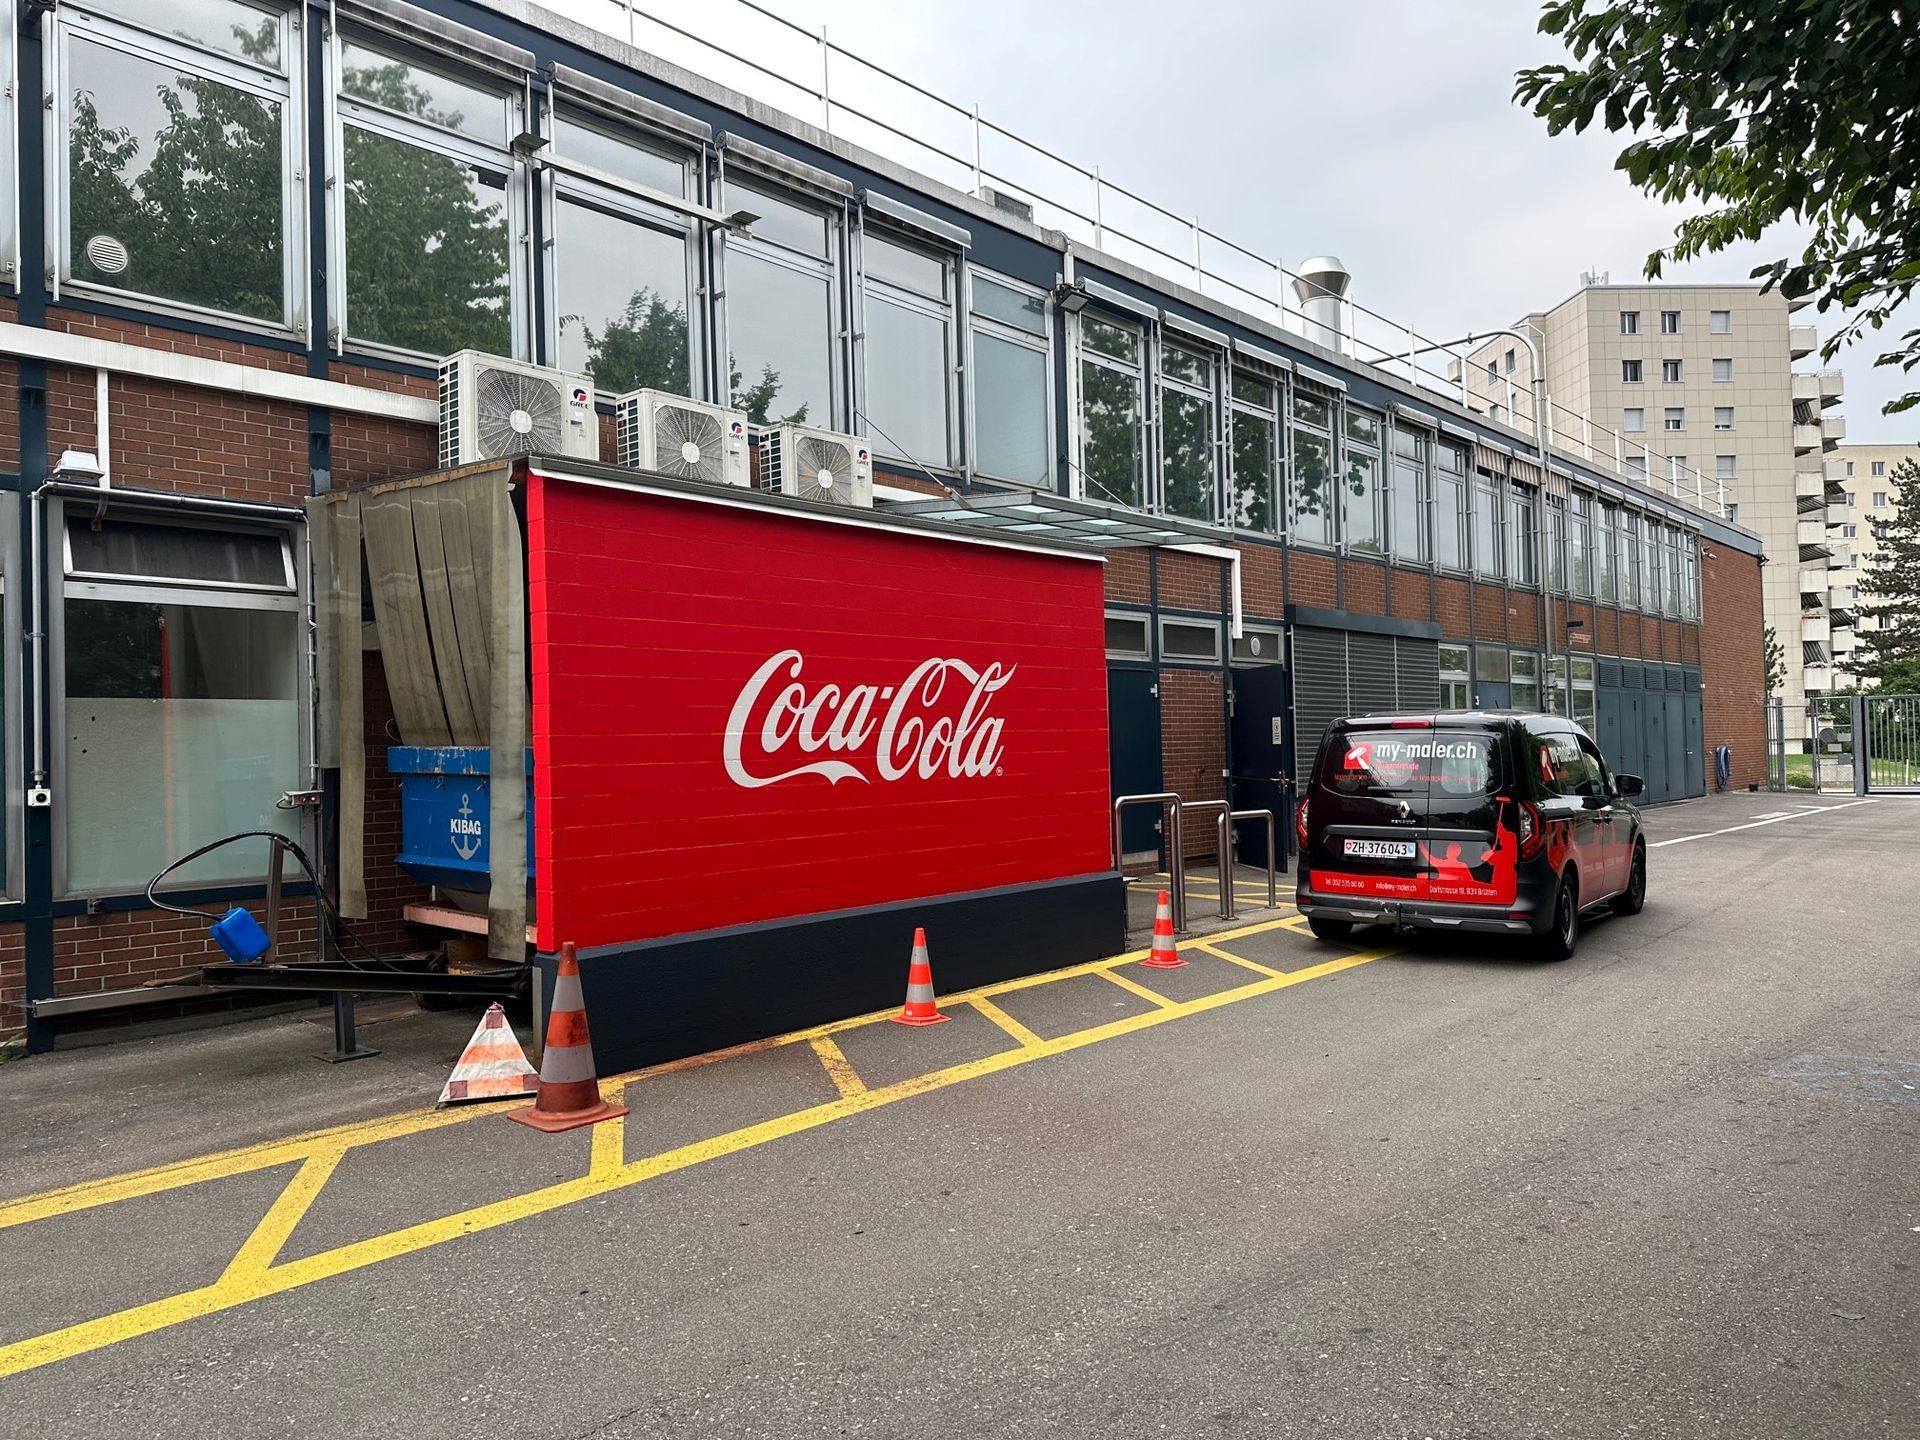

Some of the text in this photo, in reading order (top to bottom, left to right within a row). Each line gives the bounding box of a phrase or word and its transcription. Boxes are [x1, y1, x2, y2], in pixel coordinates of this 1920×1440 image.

[569, 400, 589, 410] GREE
[724, 649, 1018, 788] Coca-Cola
[1376, 740, 1477, 761] my-maler.ch
[450, 818, 481, 835] KIBAG
